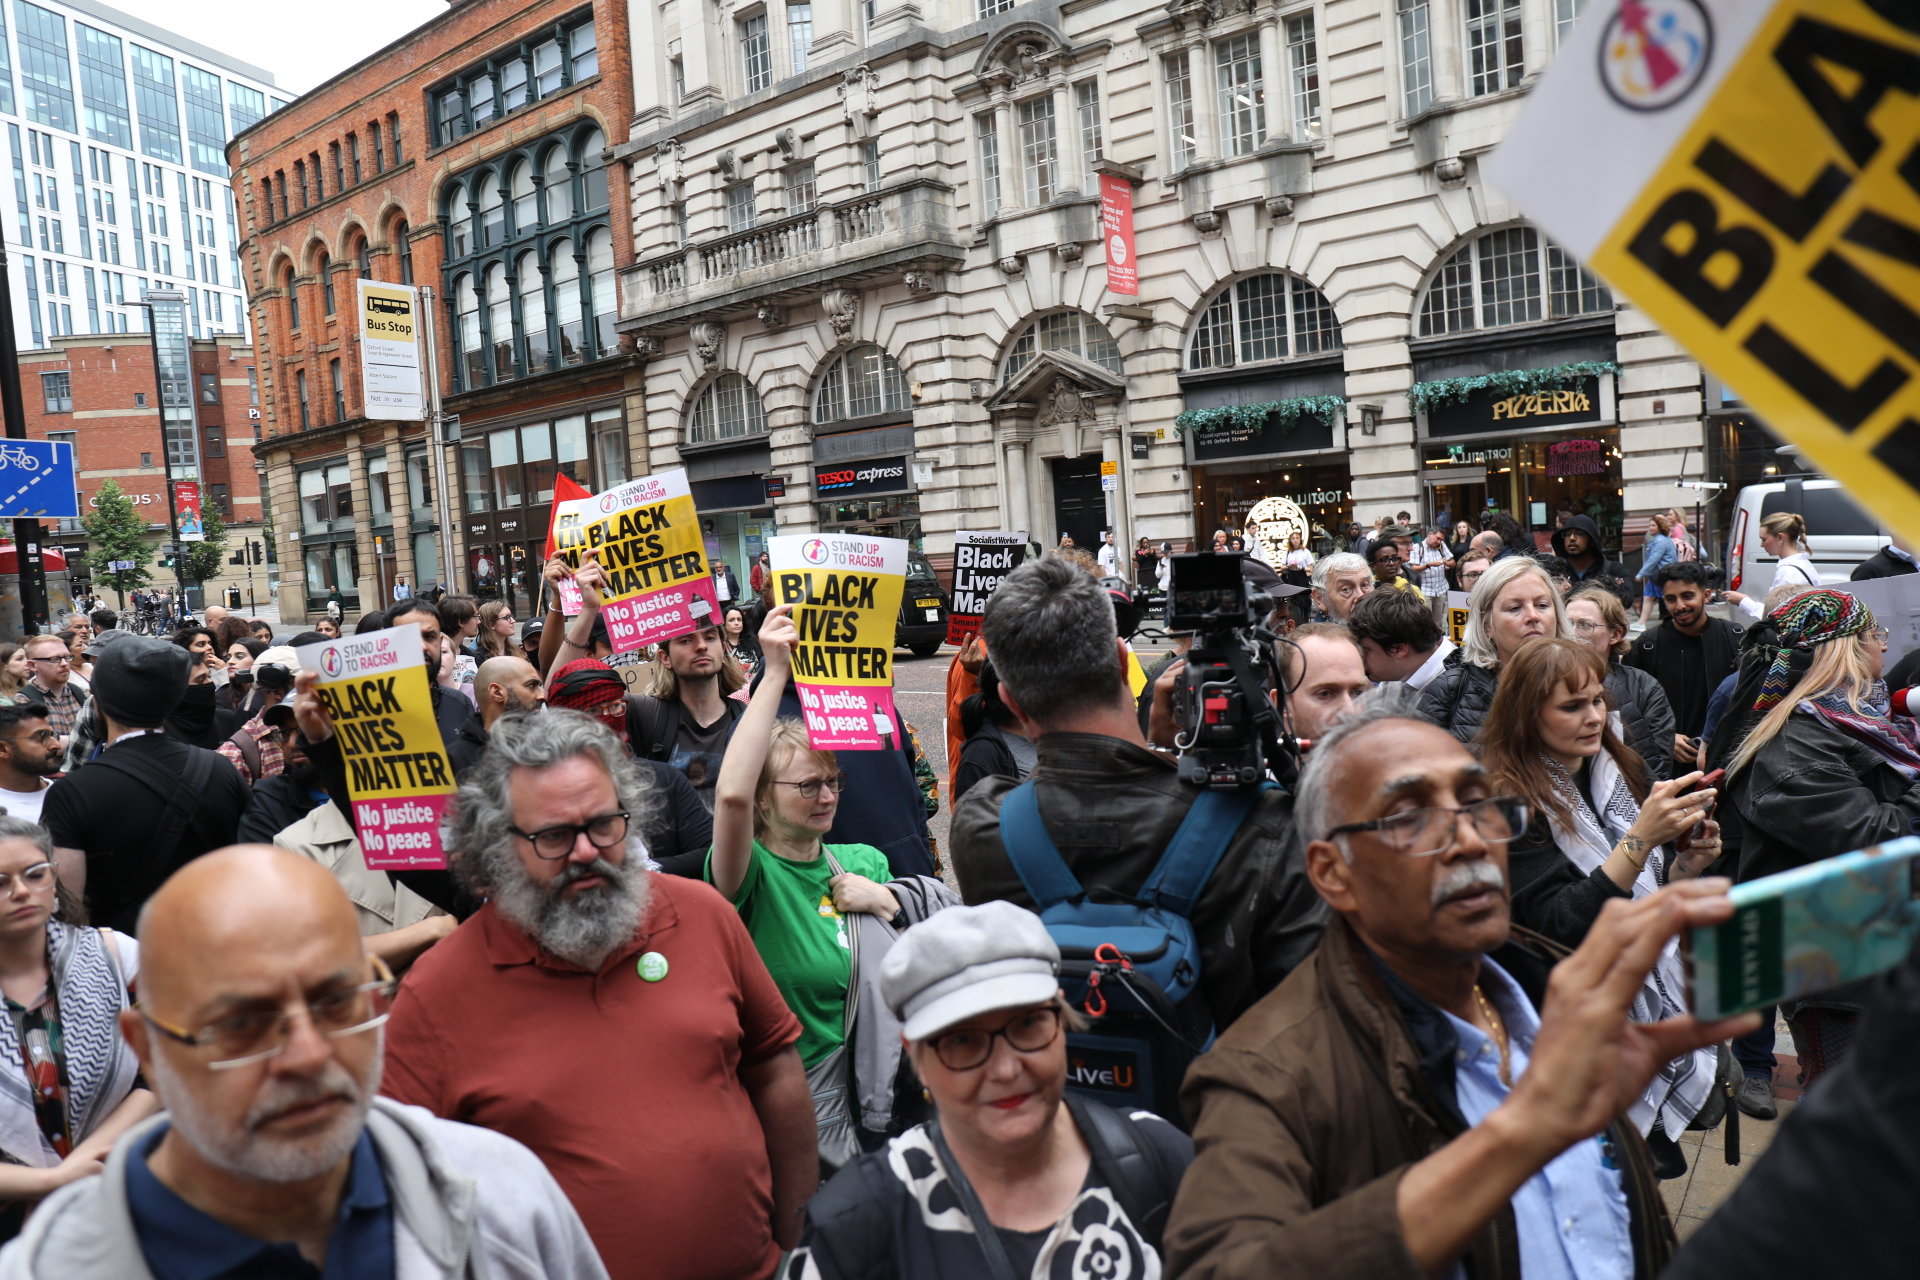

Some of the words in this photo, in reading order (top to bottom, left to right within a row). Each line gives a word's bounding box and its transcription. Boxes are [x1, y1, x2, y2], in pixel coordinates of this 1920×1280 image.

[1626, 0, 1920, 331] BLA
[367, 319, 386, 331] Bus
[388, 322, 412, 336] Stop
[1492, 390, 1590, 420] PIZZERIA
[817, 470, 856, 484] TESCO
[856, 466, 904, 483] express
[620, 482, 646, 498] STAND
[646, 480, 659, 490] UP
[622, 498, 634, 507] TO
[634, 488, 666, 504] RACISM
[588, 504, 671, 549] BLACK
[595, 534, 664, 571] LIVES
[832, 540, 864, 554] STAND
[866, 544, 880, 554] UP
[969, 536, 998, 544] Socialist
[833, 553, 846, 564] TO
[849, 555, 884, 568] RACISM
[957, 546, 1014, 569] Black
[602, 551, 704, 599] MATTER
[780, 574, 878, 609] BLACK
[608, 604, 630, 622] No
[632, 591, 684, 620] justice
[612, 622, 634, 639] No
[637, 610, 681, 635] peace
[787, 609, 859, 643] IVES
[953, 617, 978, 627] Smash
[343, 638, 373, 658] STAND
[376, 638, 389, 652] UP
[345, 658, 358, 672] TO
[360, 652, 398, 670] RACISM
[791, 646, 887, 679] MATTER
[317, 676, 402, 722] BLACK
[800, 687, 820, 708] No
[821, 690, 868, 714] justice
[808, 711, 826, 732] No
[830, 714, 868, 736] peace
[333, 718, 405, 756] LIVES
[348, 752, 450, 792] MATTER
[358, 804, 380, 826] No
[382, 804, 434, 830] justice
[362, 829, 384, 851] No
[386, 831, 432, 855] peace
